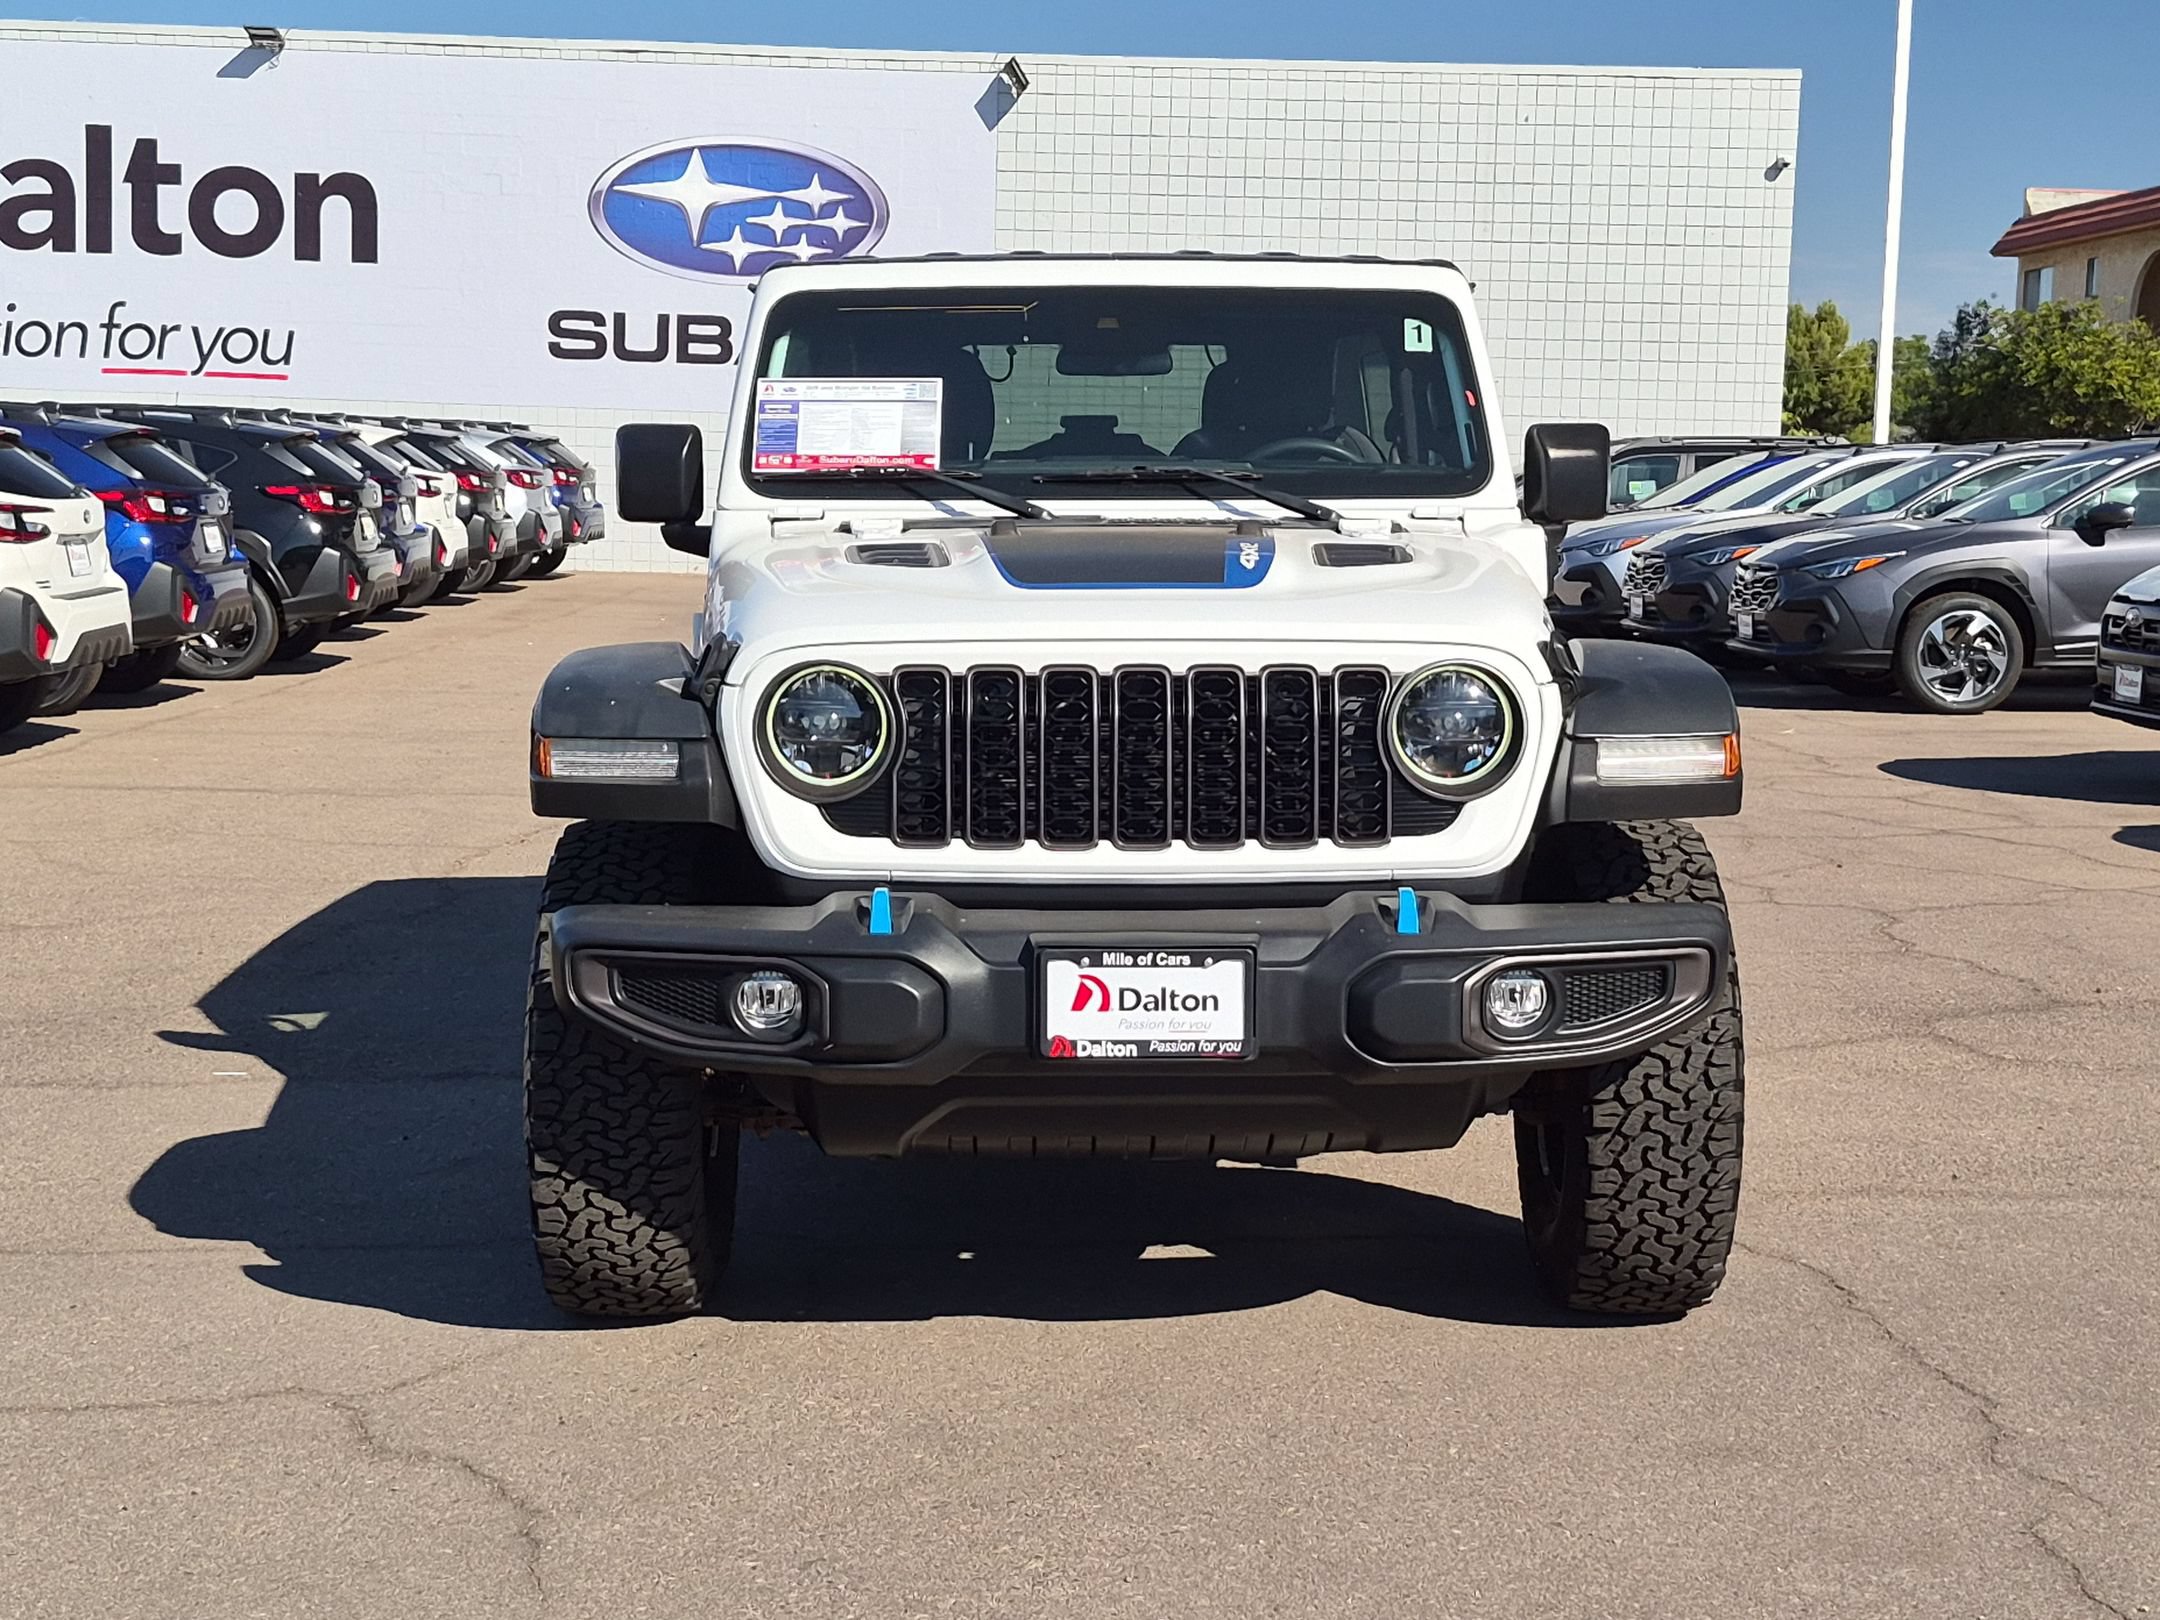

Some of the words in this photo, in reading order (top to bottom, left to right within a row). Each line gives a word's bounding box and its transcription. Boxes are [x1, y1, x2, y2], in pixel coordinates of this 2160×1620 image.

[0, 302, 89, 359] ion
[99, 300, 182, 360] for
[190, 325, 295, 376] you
[547, 309, 740, 366] SUB
[1410, 323, 1423, 344] 1
[1102, 952, 1134, 966] Mile
[1136, 952, 1154, 966] of
[1156, 952, 1192, 966] Cars
[1118, 986, 1220, 1012] Dalton
[1117, 1017, 1165, 1030] Passion
[1167, 1017, 1188, 1031] for
[1188, 1020, 1212, 1032] you
[1076, 1040, 1138, 1058] Dalton
[1149, 1040, 1197, 1053] Passion
[1197, 1039, 1219, 1053] for
[1218, 1041, 1242, 1055] you
